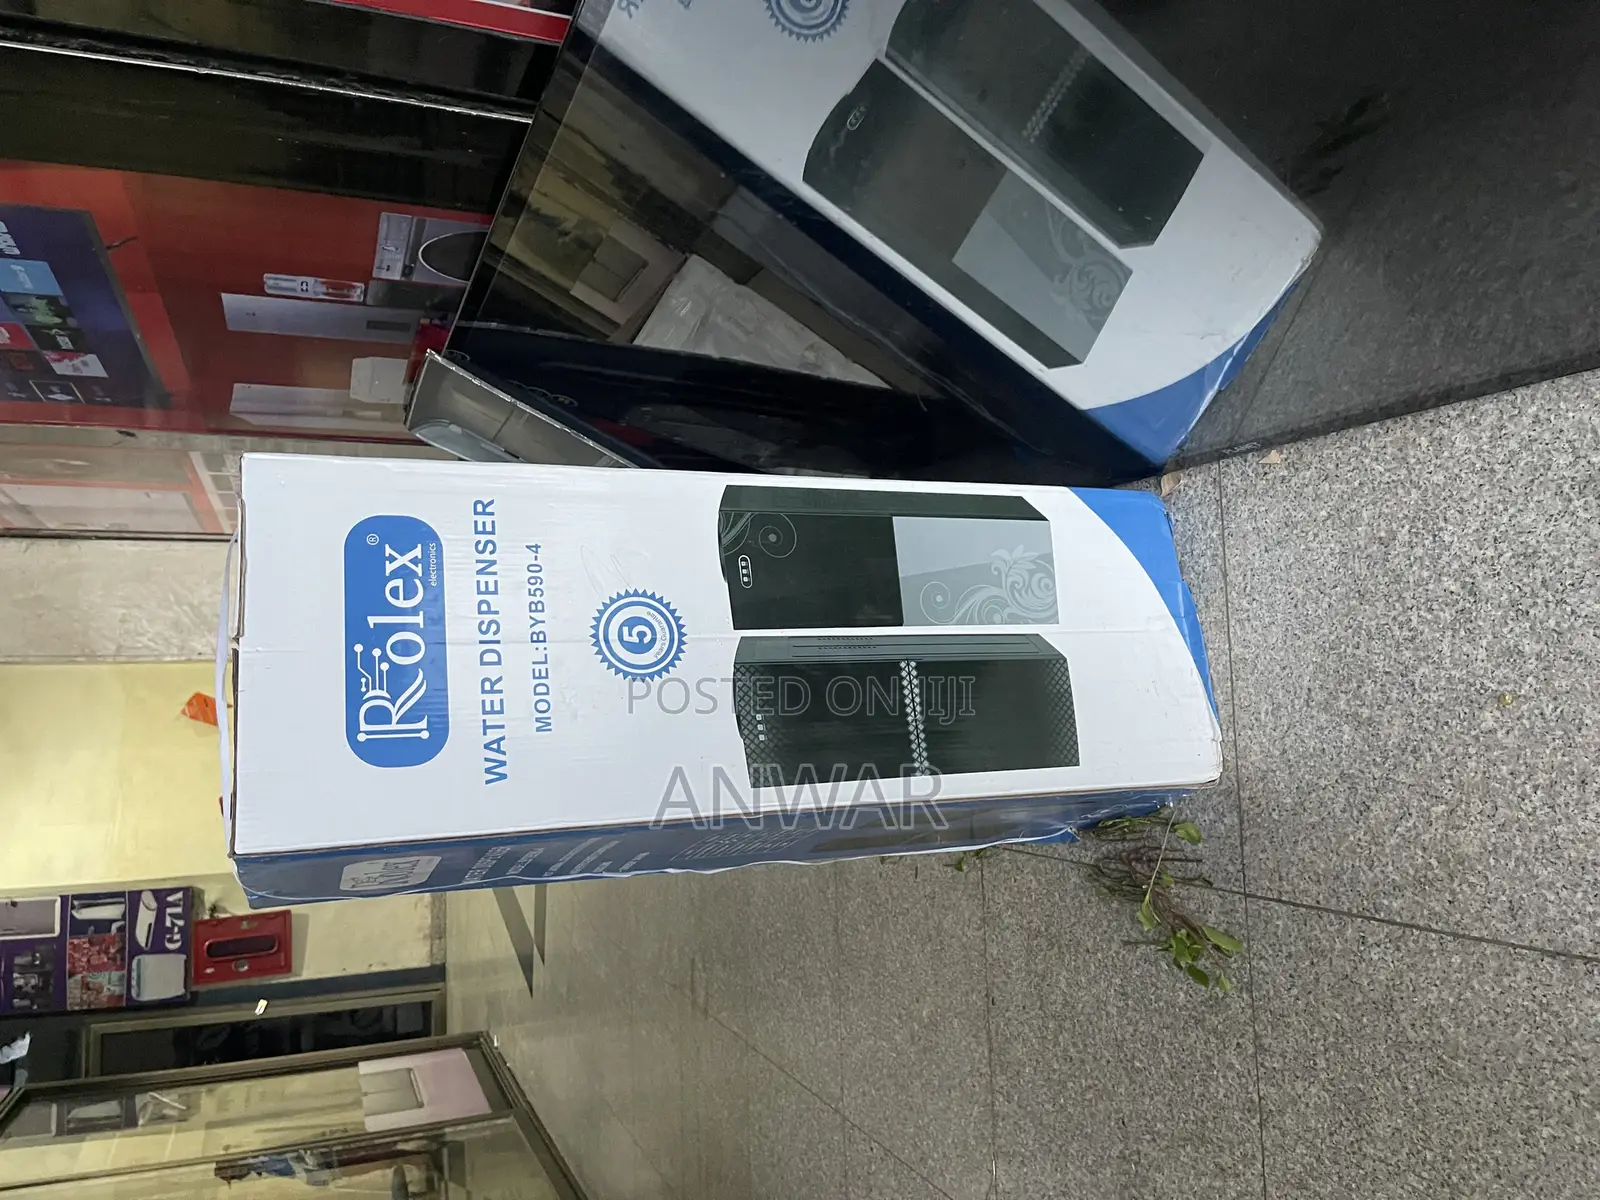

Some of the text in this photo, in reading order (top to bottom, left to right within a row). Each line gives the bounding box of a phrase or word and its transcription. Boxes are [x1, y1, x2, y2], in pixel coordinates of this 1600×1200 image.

[355, 543, 430, 742] Rolex
[429, 541, 437, 587] electronics
[473, 498, 508, 785] WATER DISPENSER
[525, 543, 552, 732] MODEL:BYB590-4
[622, 624, 652, 644] 5
